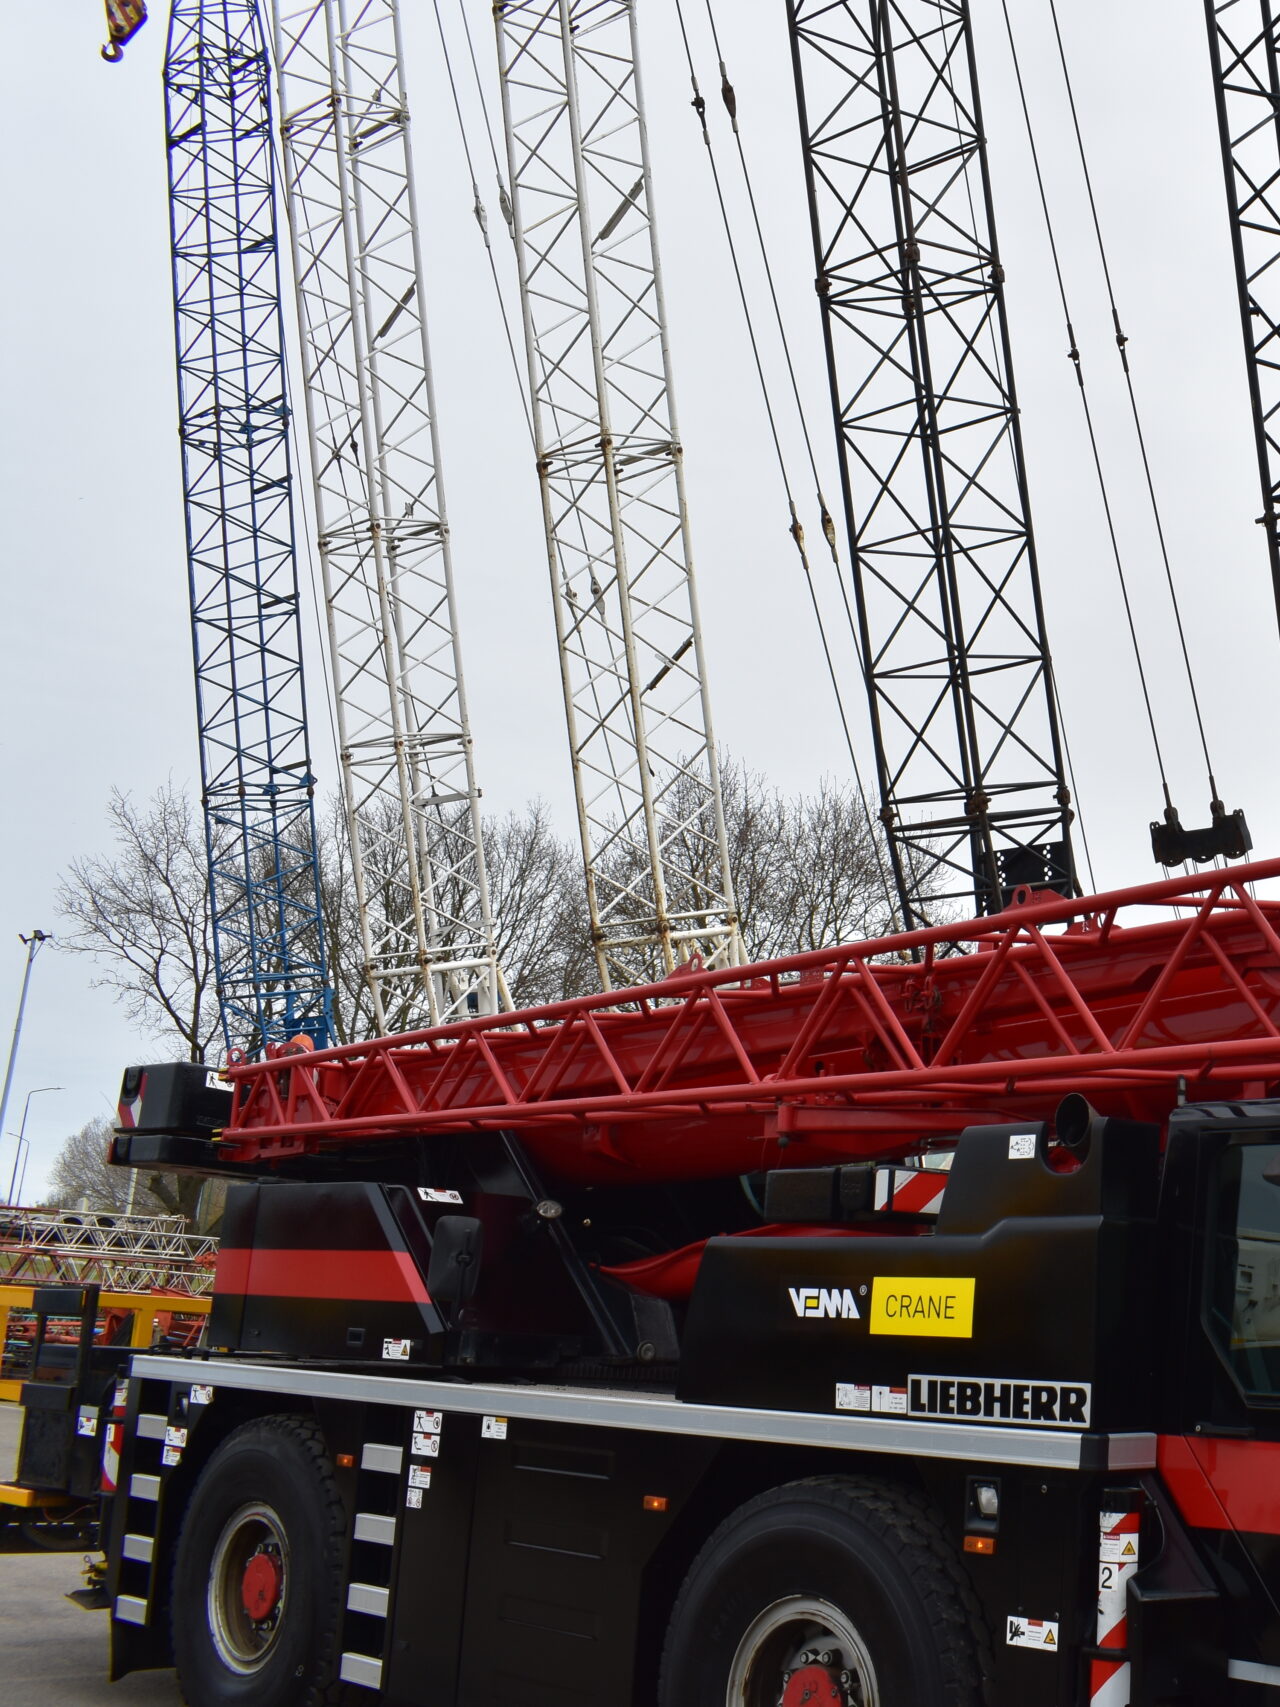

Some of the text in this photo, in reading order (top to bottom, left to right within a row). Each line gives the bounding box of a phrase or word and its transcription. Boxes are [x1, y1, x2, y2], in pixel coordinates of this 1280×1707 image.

[788, 1287, 956, 1319] VEMA CRANE
[910, 1378, 1087, 1423] LIEBHERR
[1101, 1566, 1112, 1589] 2
